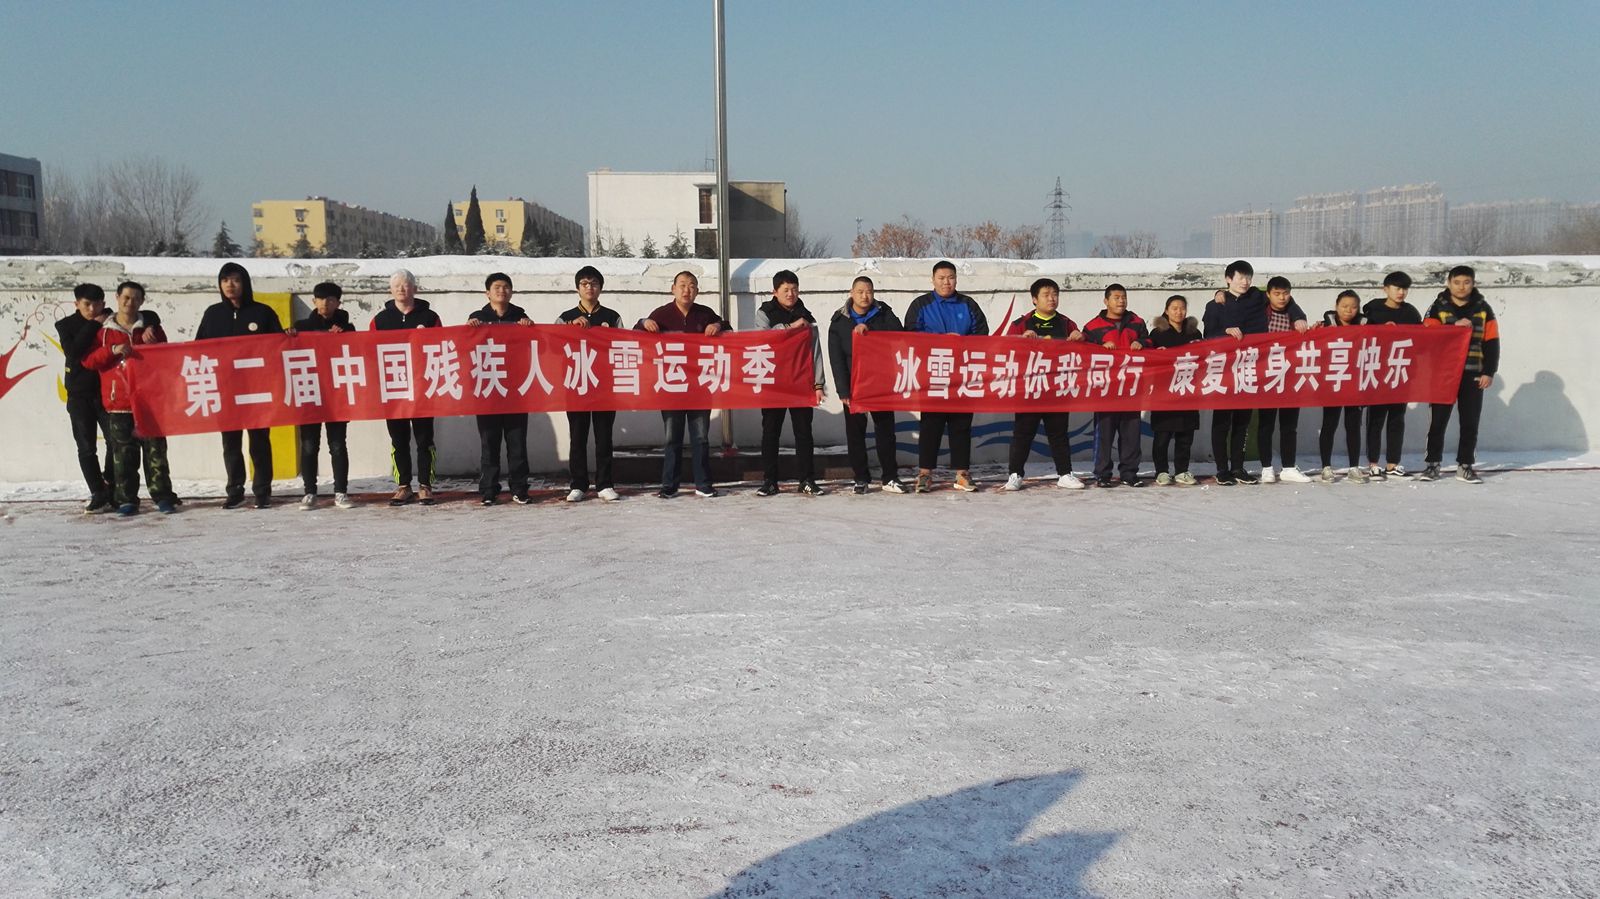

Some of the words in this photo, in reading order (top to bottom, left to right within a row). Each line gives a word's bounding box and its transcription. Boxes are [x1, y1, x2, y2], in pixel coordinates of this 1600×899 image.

[180, 338, 776, 417] 第二届中国残疾人冰雪运动季
